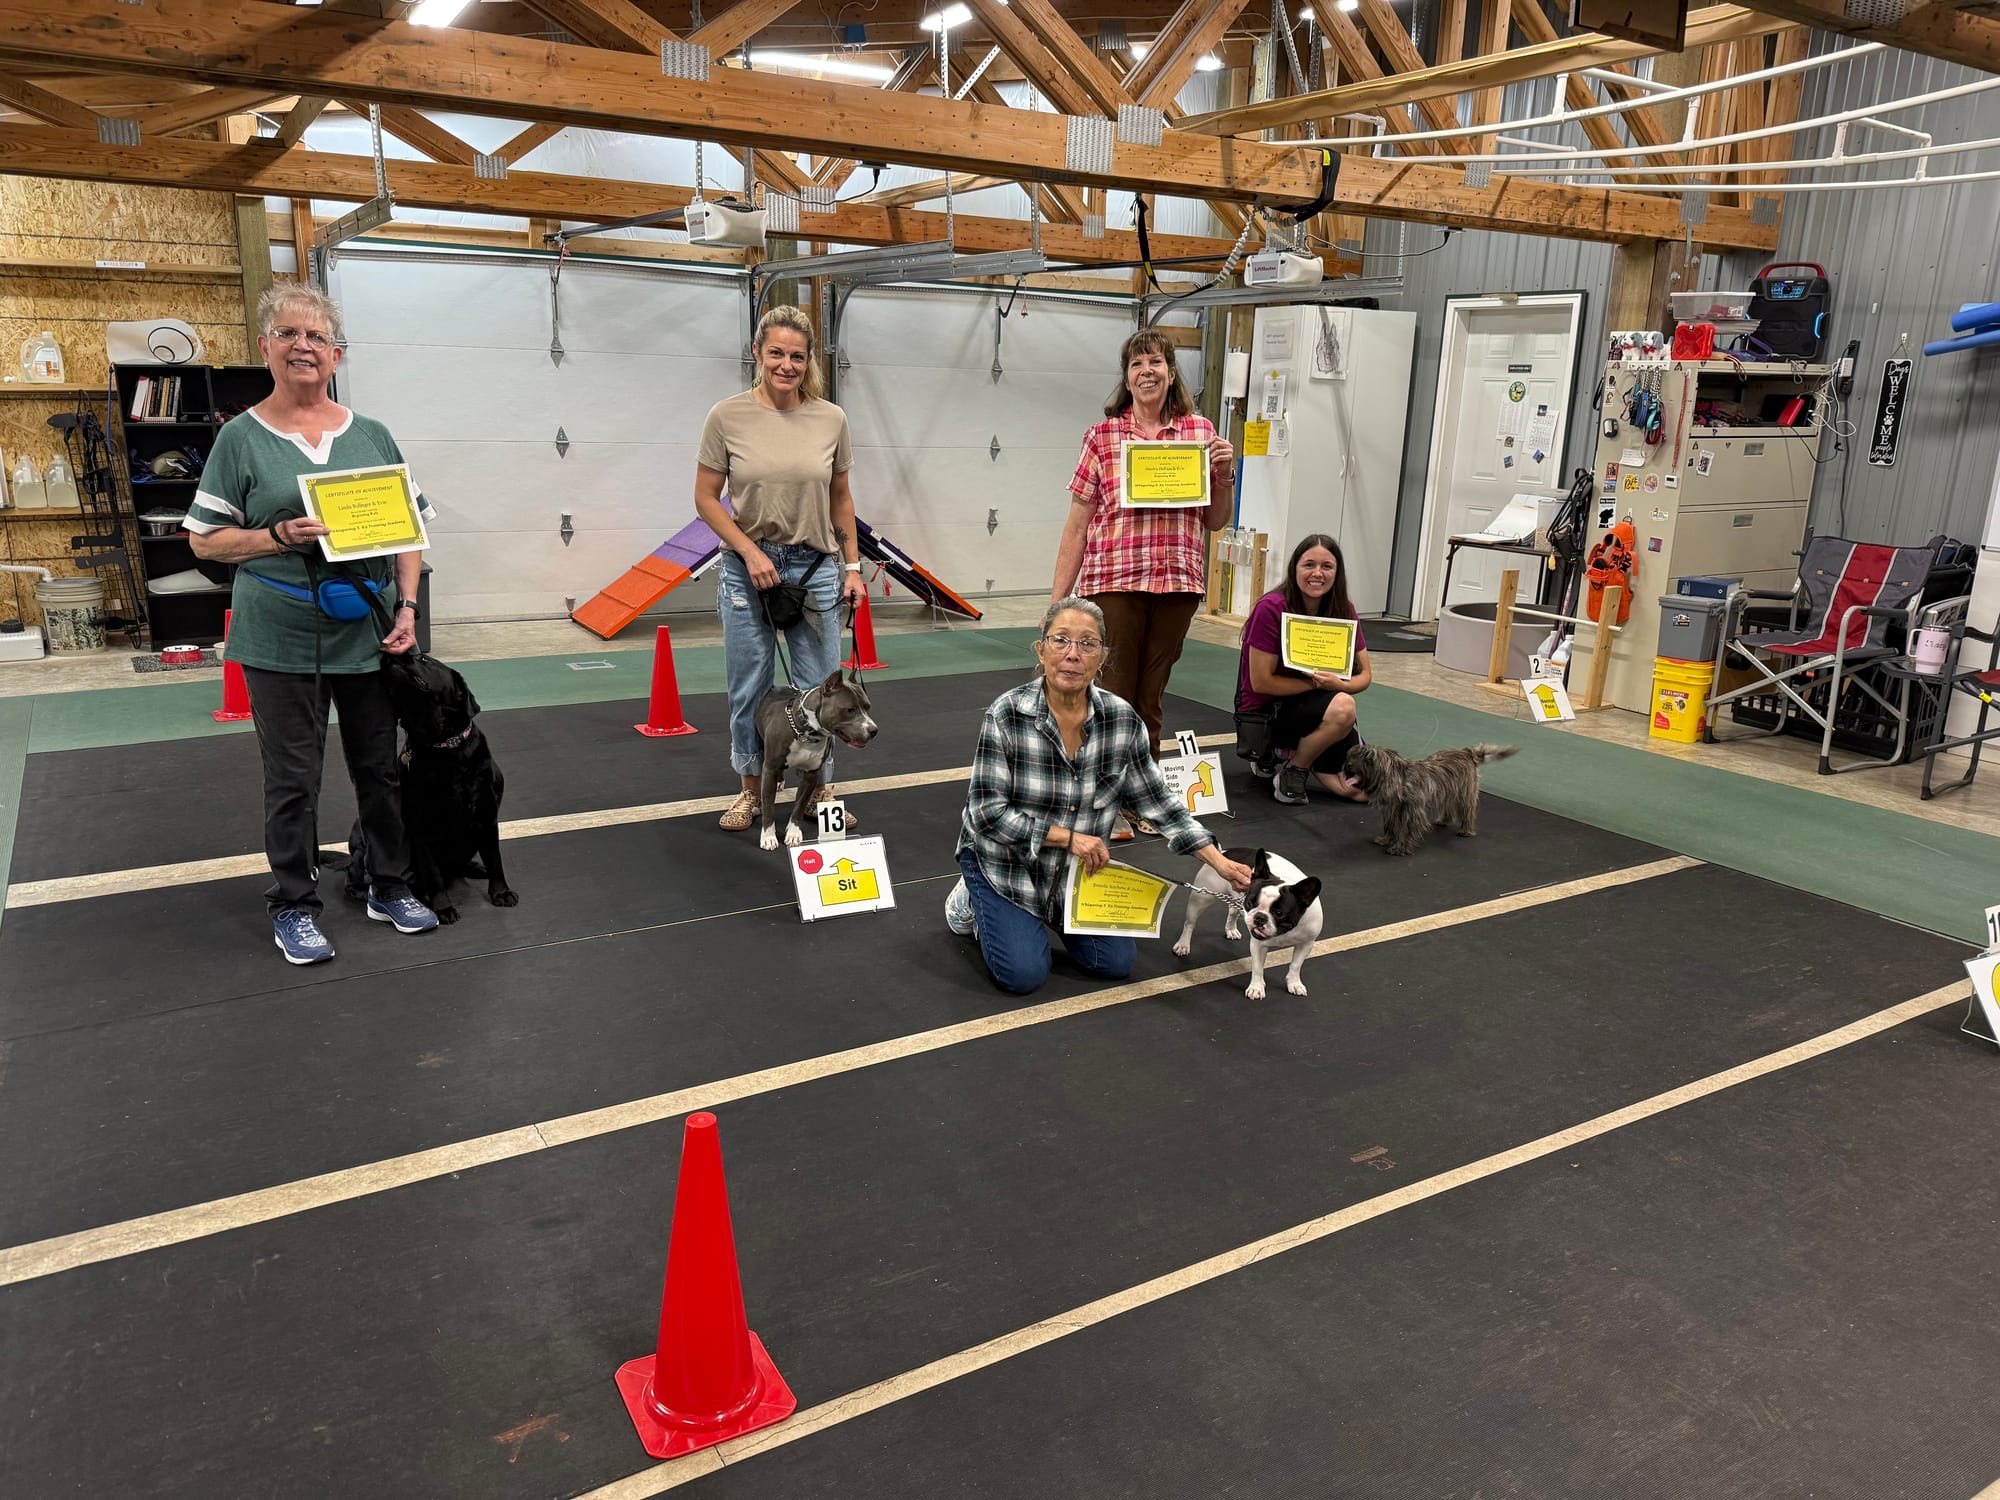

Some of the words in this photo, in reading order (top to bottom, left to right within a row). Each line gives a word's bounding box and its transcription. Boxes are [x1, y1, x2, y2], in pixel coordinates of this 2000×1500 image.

[1880, 375, 1903, 445] WELCME
[1533, 658, 1541, 673] 2
[1179, 734, 1197, 755] 11
[819, 806, 844, 832] 13
[838, 878, 857, 891] Sit
[1988, 912, 2000, 943] 1
